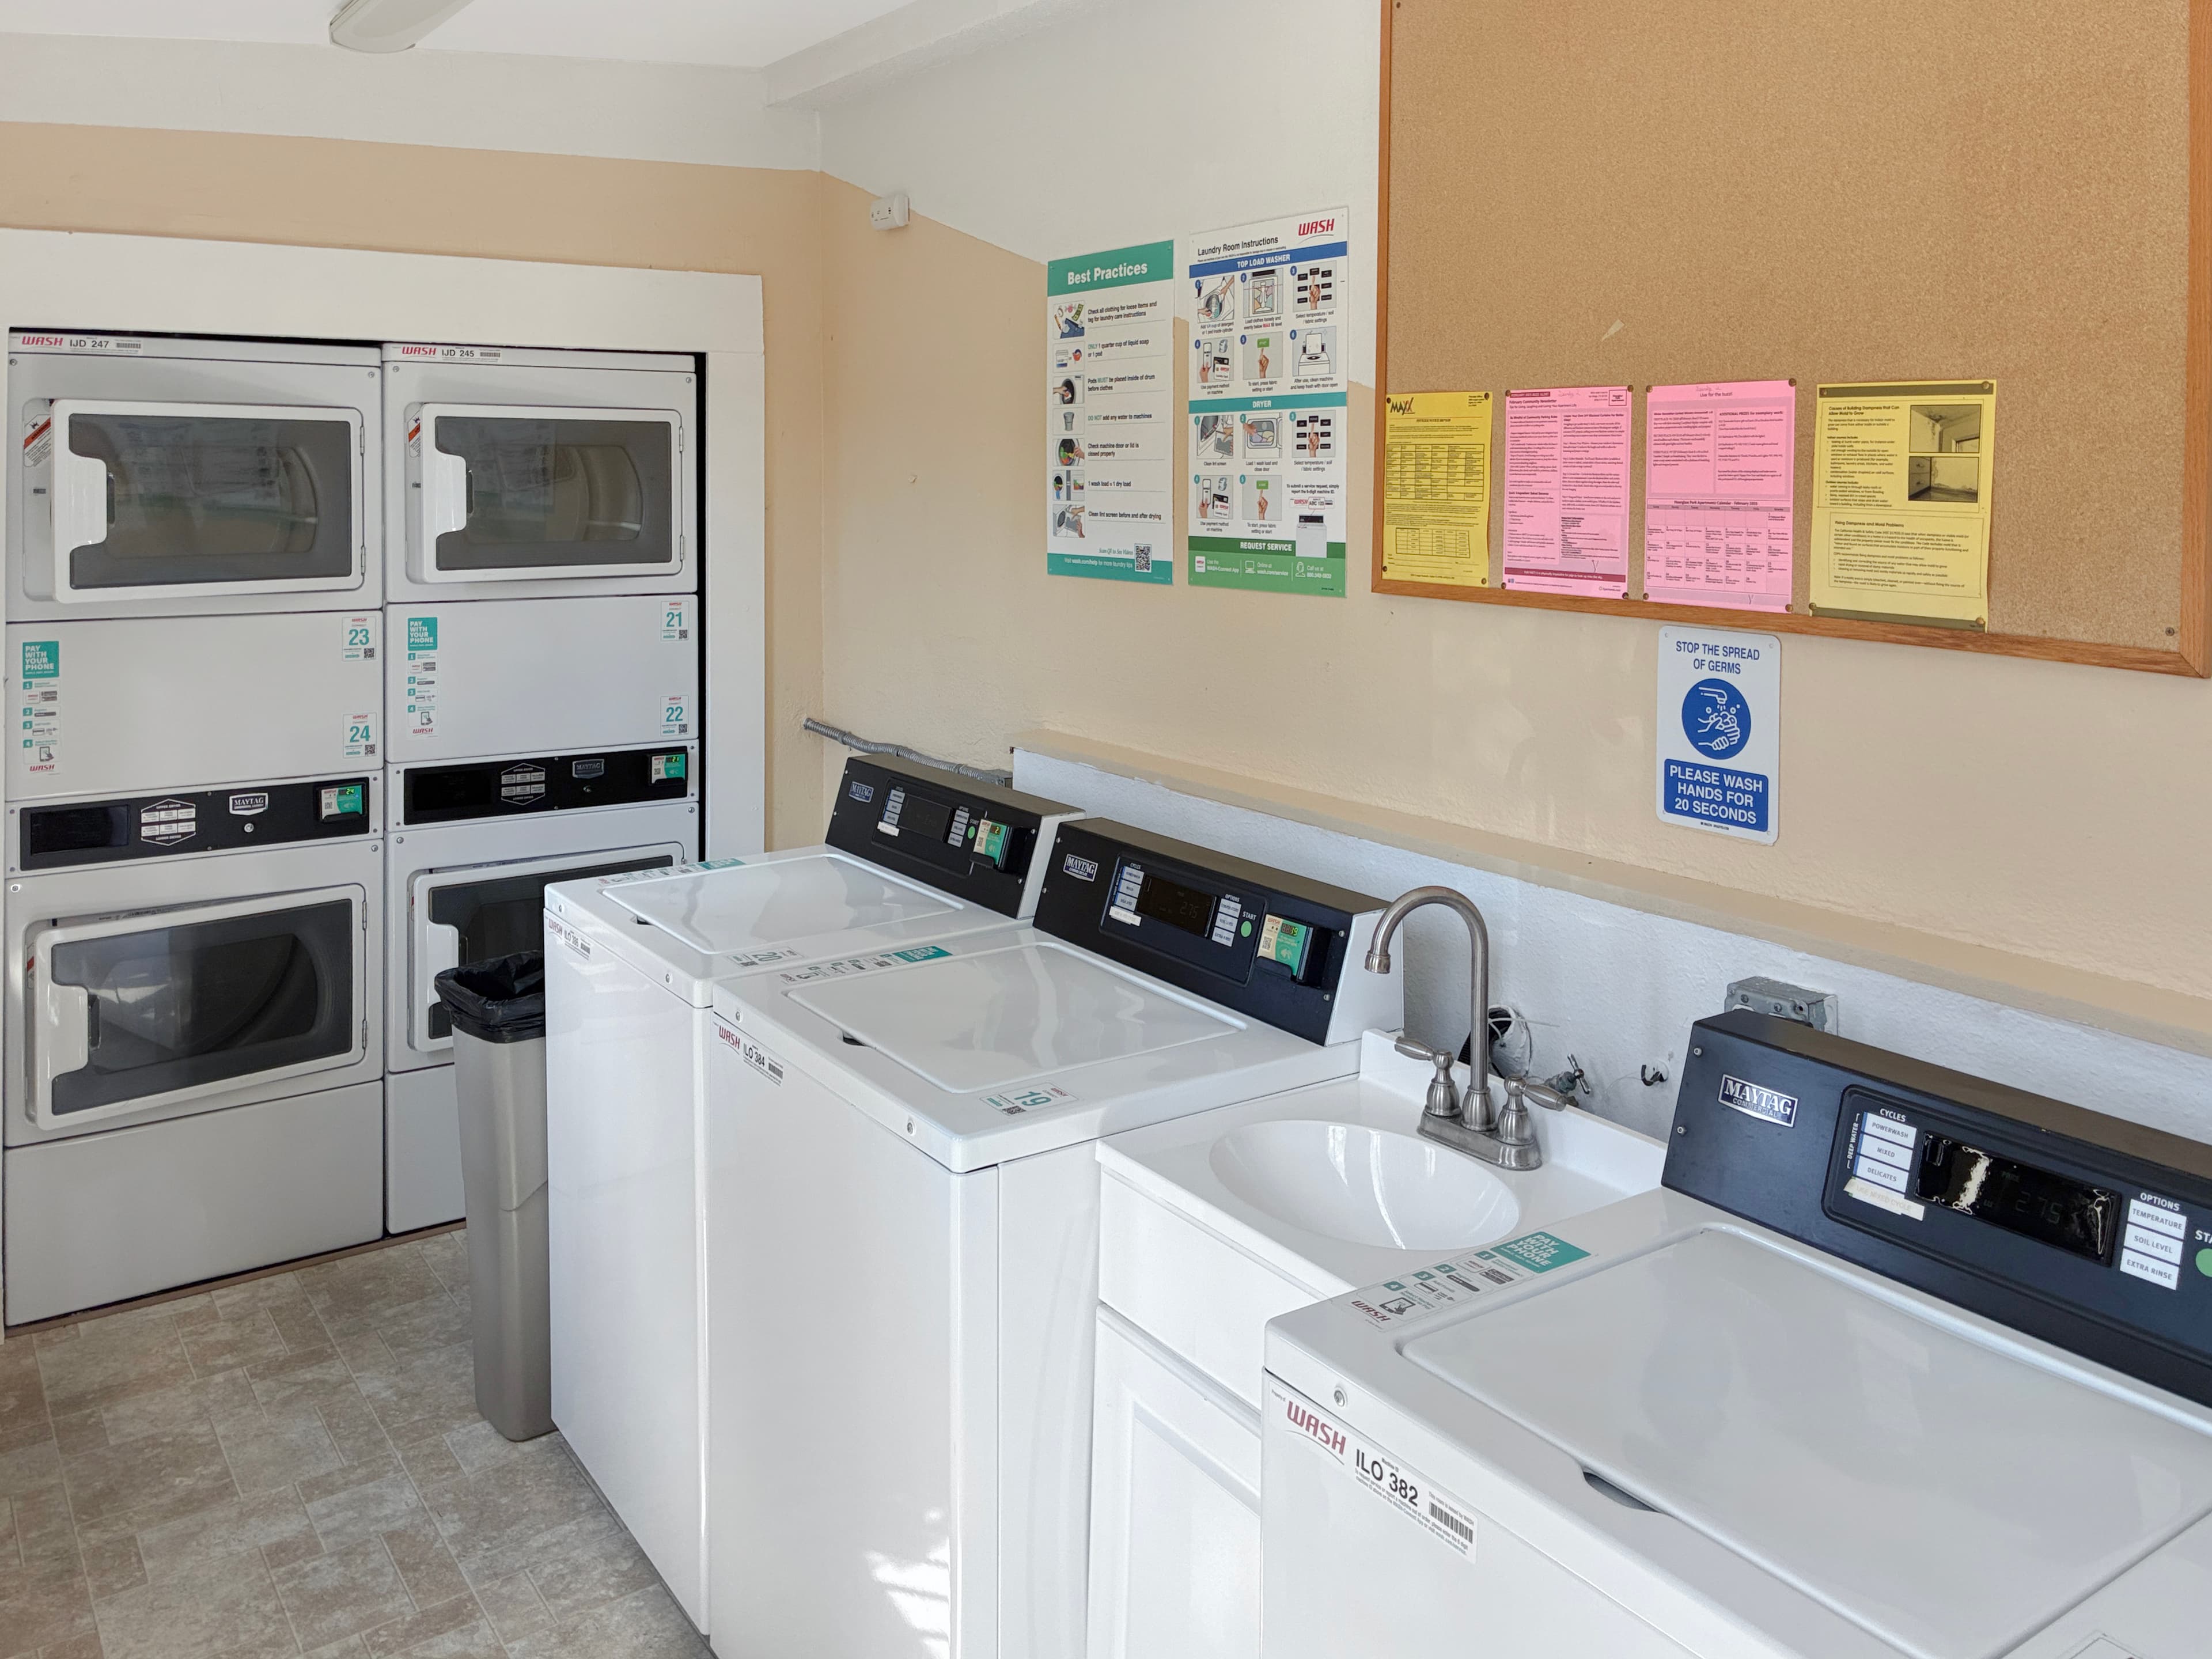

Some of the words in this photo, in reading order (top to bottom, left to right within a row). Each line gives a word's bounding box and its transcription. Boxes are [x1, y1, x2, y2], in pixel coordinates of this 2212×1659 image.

[1298, 218, 1335, 236] WASH
[1198, 247, 1221, 256] Laundry
[1223, 242, 1240, 251] Room
[1241, 237, 1278, 248] Instructions
[1237, 260, 1248, 268] TOP
[1249, 257, 1264, 267] LOAD
[1266, 254, 1290, 264] WASHER
[1067, 269, 1090, 285] Best
[1094, 263, 1147, 281] Practices
[1100, 313, 1113, 321] laundry
[1105, 306, 1120, 315] clothing
[22, 336, 63, 346] WASH
[70, 339, 86, 347] IJD
[92, 340, 109, 349] 247
[402, 347, 436, 355] WASH
[1240, 541, 1266, 550] REQUEST
[1267, 543, 1292, 551] SERVICE
[666, 612, 682, 627] 21
[349, 628, 369, 646] 23
[1676, 641, 1699, 653] STOP
[1702, 644, 1719, 656] THE
[1722, 646, 1760, 660] SPREAD
[1694, 659, 1706, 669] OF
[1709, 660, 1741, 674] GERMS
[666, 707, 683, 722] 22
[350, 725, 370, 743] 24
[1670, 765, 1719, 785] PLEASE
[1724, 774, 1762, 793] WASH
[852, 783, 871, 796] MAYTAG
[1677, 783, 1722, 800] HANDS
[1726, 791, 1753, 807] FOR
[234, 797, 264, 806] MAYTAG
[1675, 798, 1688, 811] 20
[1692, 802, 1756, 824] SECONDS
[1067, 857, 1094, 874] MAYTAG
[1225, 894, 1240, 902] OPTIONS
[1243, 911, 1256, 921] START
[549, 918, 563, 935] WASH
[752, 952, 782, 963] 20
[719, 1025, 740, 1049] WASH
[744, 1043, 753, 1059] ILO
[755, 1052, 765, 1067] 384
[1724, 1080, 1792, 1116] MAYTAG
[1733, 1097, 1779, 1118] COMMERCIAL
[1880, 1108, 1906, 1122] CYCLES
[1850, 1123, 1859, 1142] WATER
[1872, 1122, 1908, 1139] POWERWASH
[1847, 1143, 1856, 1159] DEEP
[1877, 1147, 1895, 1158] MIXED
[1867, 1167, 1897, 1181] DELICATES
[1891, 1198, 1911, 1211] CYCLE
[2140, 1192, 2180, 1211] OPTIONS
[2133, 1209, 2183, 1230] TEMPERATURE
[1524, 1237, 1559, 1255] WITH
[1533, 1234, 1559, 1246] PAY
[2134, 1235, 2150, 1246] SOIL
[2152, 1240, 2173, 1253] LEVEL
[1507, 1244, 1552, 1266] PHONE
[1517, 1241, 1552, 1259] YOUR
[2127, 1259, 2149, 1272] EXTRA
[2152, 1268, 2172, 1280] RINSE
[1351, 1301, 1391, 1321] WASH
[1287, 1400, 1346, 1455] WASH
[1355, 1449, 1383, 1481] ILO
[1389, 1473, 1418, 1507] 382
